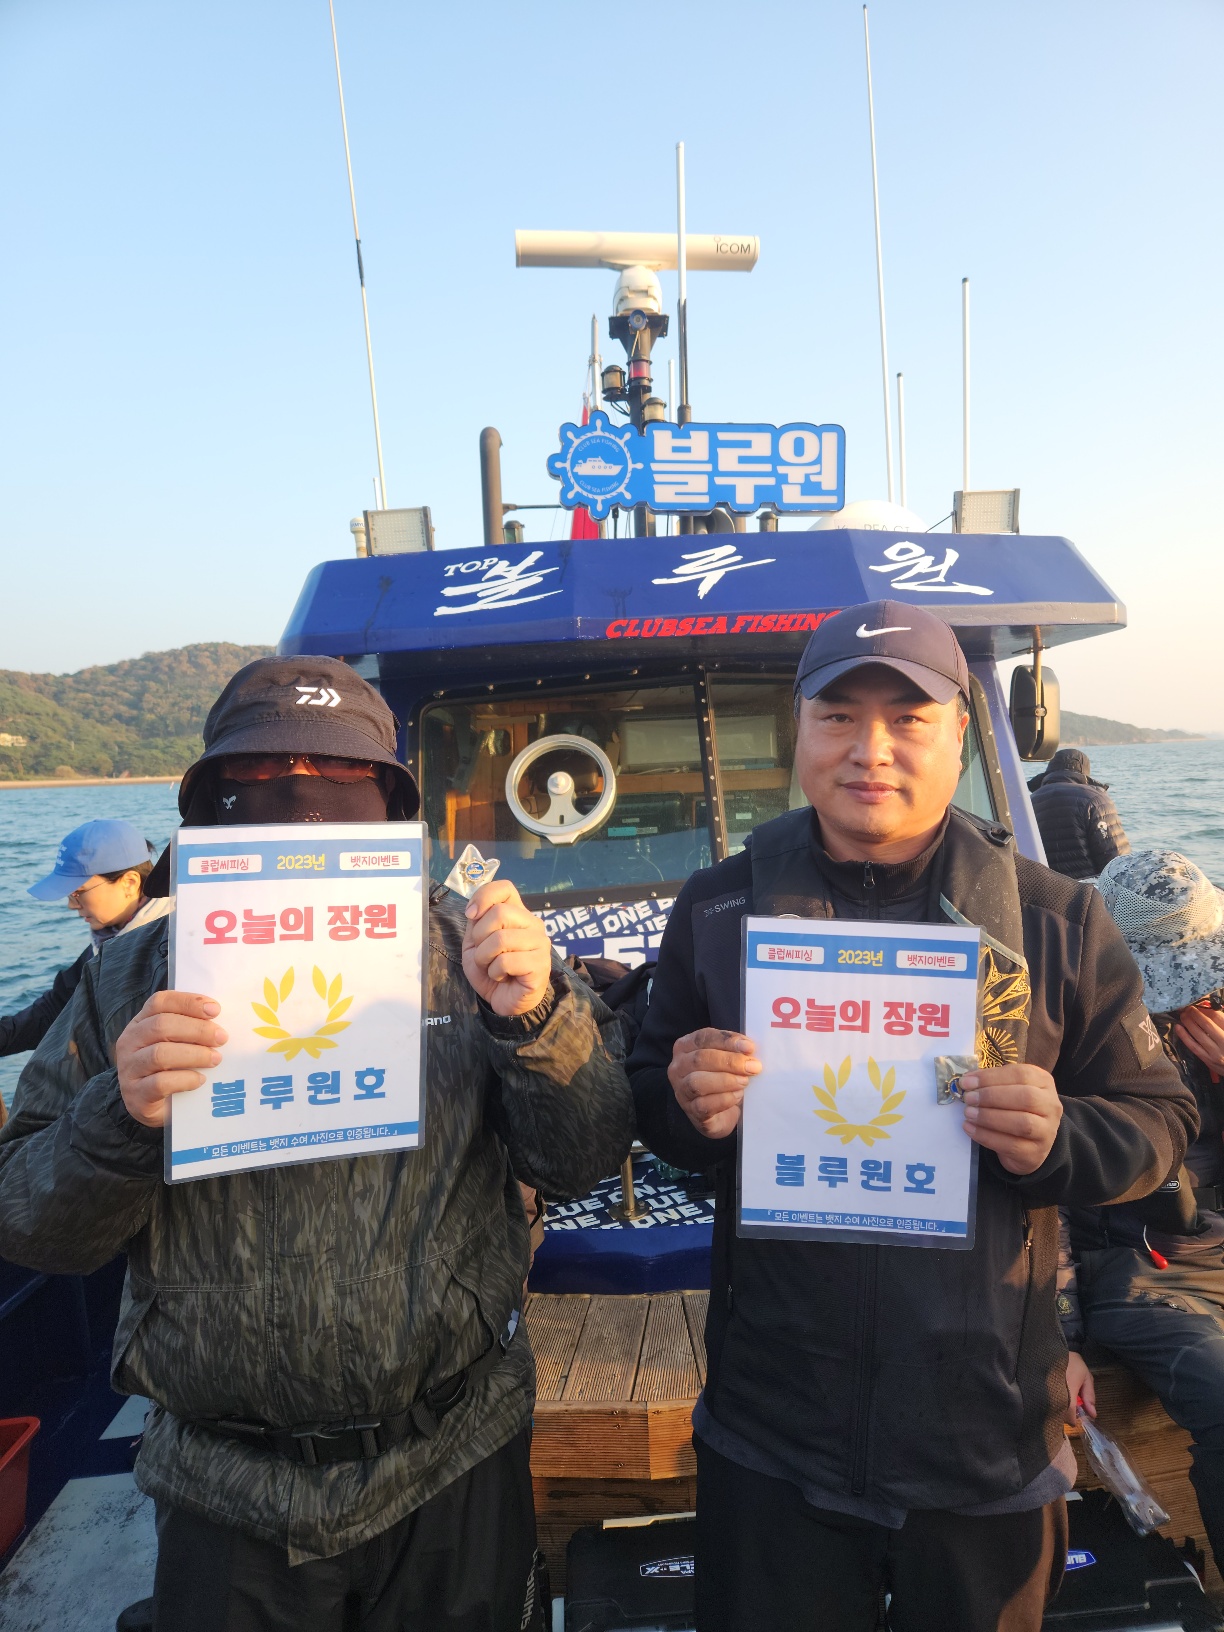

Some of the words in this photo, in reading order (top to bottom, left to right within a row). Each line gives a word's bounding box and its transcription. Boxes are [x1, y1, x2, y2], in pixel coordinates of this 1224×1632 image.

[650, 429, 838, 504] 블루원
[443, 557, 499, 577] TOP
[605, 615, 728, 639] CLUBSEA
[200, 858, 250, 874] 클럽씨피싱
[276, 853, 326, 871] 2023년
[350, 854, 400, 869] 뱃지이벤트
[203, 906, 314, 945] 오늘의
[327, 903, 397, 942] 장원
[767, 947, 813, 962] 클럽씨피싱
[837, 949, 884, 967] 2023년
[907, 954, 956, 968] 뱃지이벤트
[770, 996, 871, 1034] 오늘의
[883, 1001, 951, 1038] 장원
[211, 1145, 229, 1157] 모든
[231, 1141, 267, 1154] 이벤트는
[291, 1135, 308, 1147] 수여
[310, 1130, 344, 1144] 사진으로
[774, 1211, 790, 1222] 모든
[791, 1212, 823, 1224] 이벤트는
[844, 1216, 860, 1226] 수여
[862, 1216, 894, 1228] 사진으로
